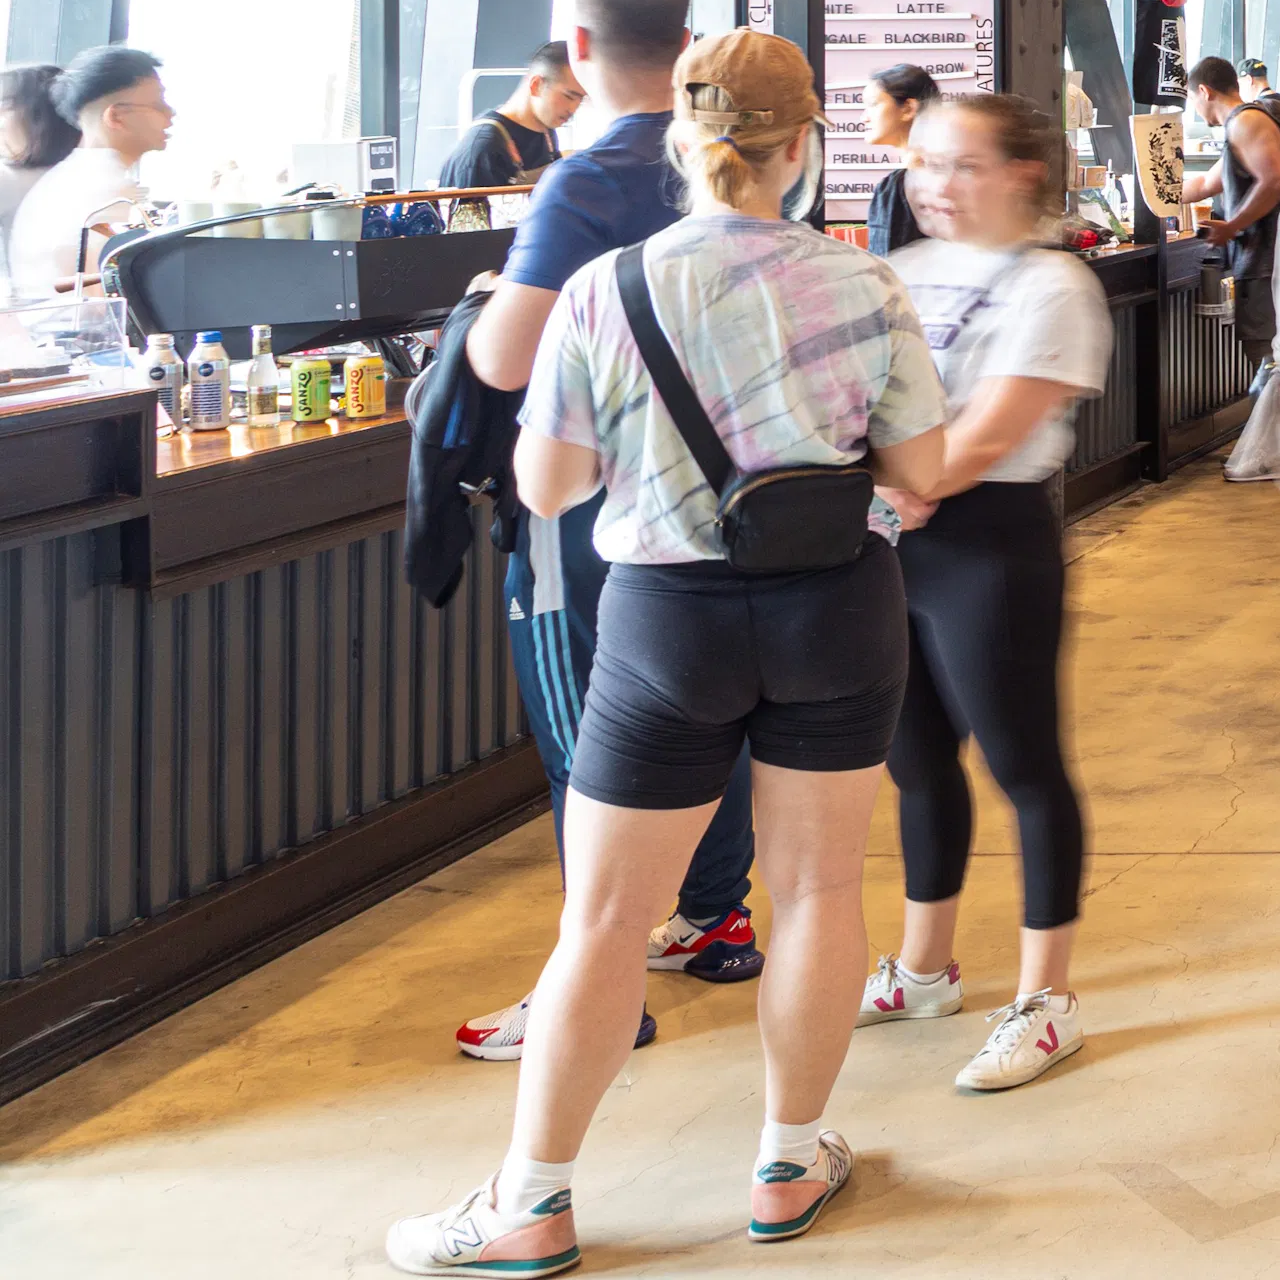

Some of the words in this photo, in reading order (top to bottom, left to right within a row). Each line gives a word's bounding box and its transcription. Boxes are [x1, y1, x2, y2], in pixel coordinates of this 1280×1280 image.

[896, 3, 945, 14] LATTE
[825, 33, 867, 44] GALE
[884, 32, 966, 44] BLACKBIRD
[833, 153, 890, 164] PERILLA
[825, 183, 875, 194] SIONFR
[298, 371, 312, 416] SANZO
[350, 368, 364, 413] SANZO
